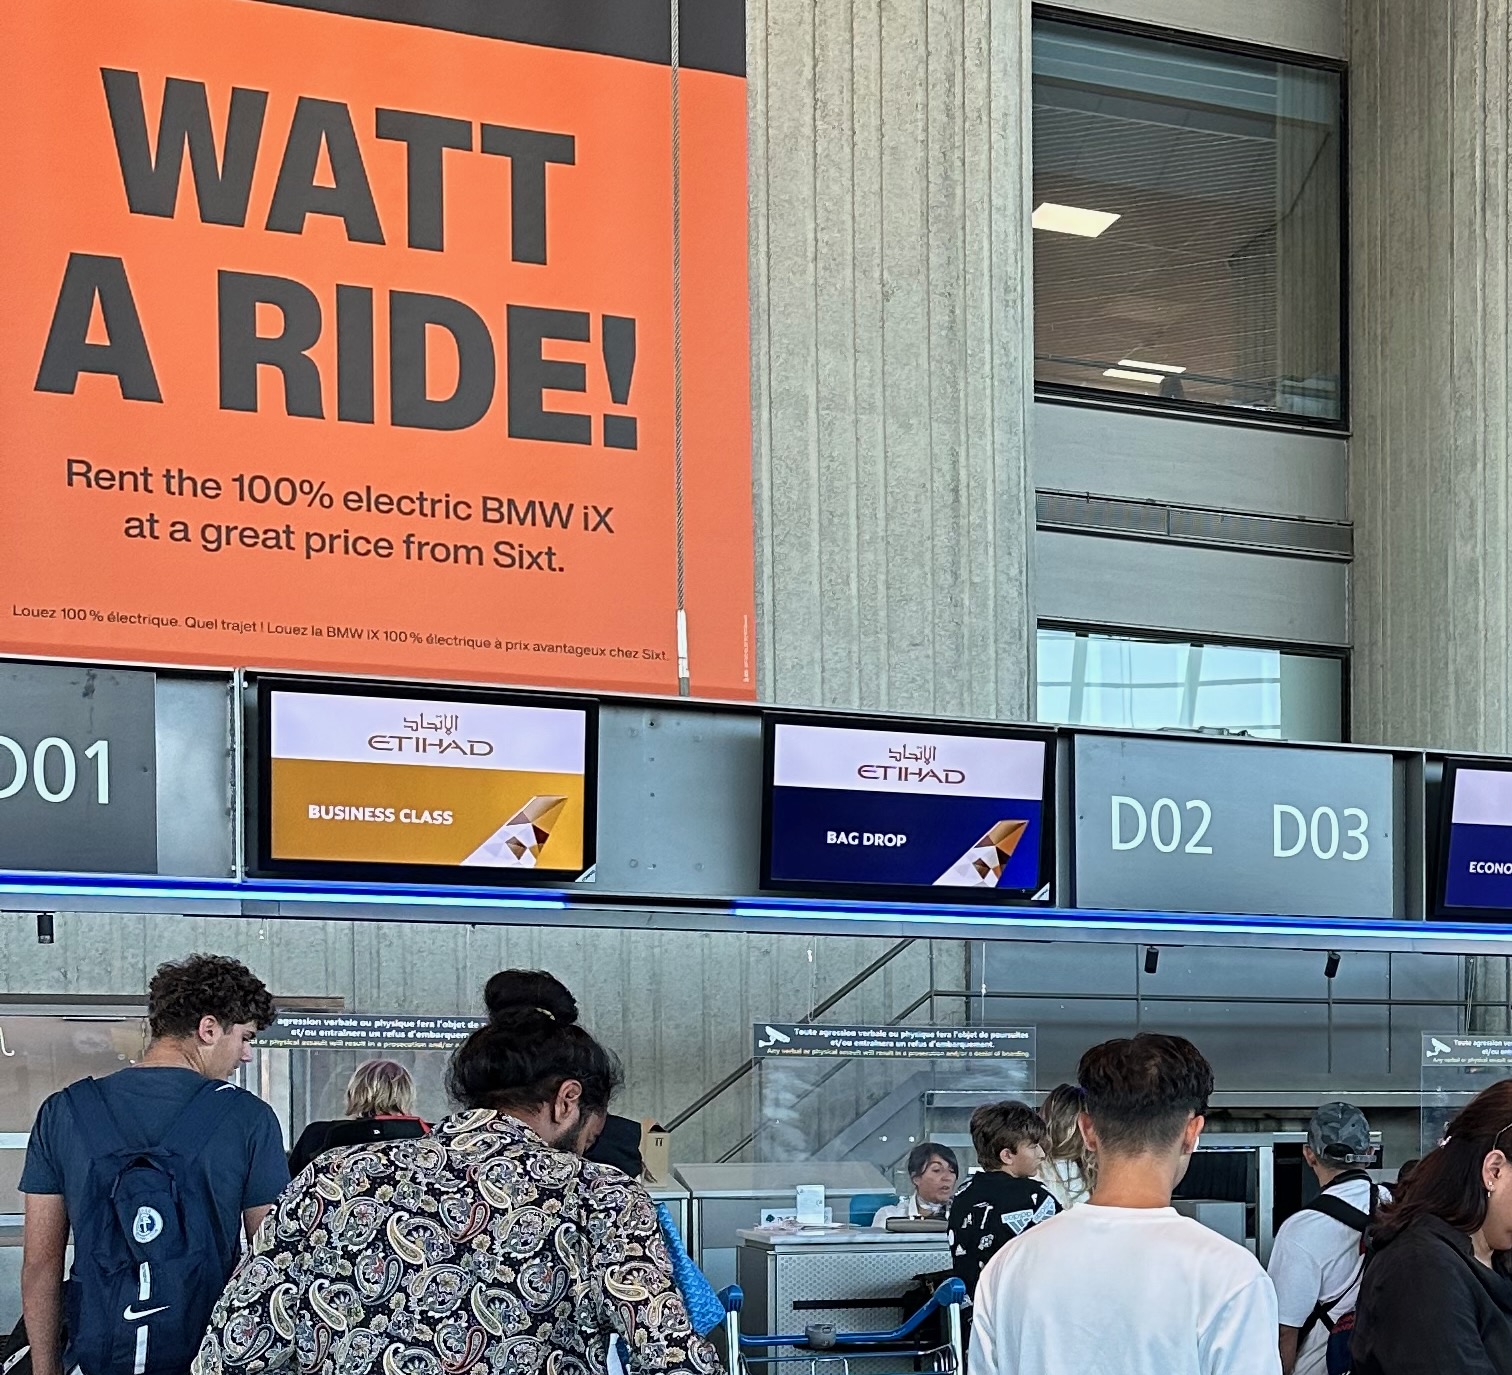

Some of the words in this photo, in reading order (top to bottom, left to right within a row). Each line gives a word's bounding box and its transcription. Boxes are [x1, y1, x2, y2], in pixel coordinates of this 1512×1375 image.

[100, 67, 576, 265] WATT
[34, 252, 163, 403] A
[217, 269, 638, 450] RIDE!
[66, 459, 153, 496] Rent
[163, 468, 222, 499] the
[232, 474, 334, 510] 100%
[343, 485, 472, 522] electric
[482, 497, 574, 529] BMW
[582, 503, 615, 534] iX
[124, 514, 159, 539] at
[169, 521, 190, 542] a
[201, 520, 295, 552] great
[304, 528, 393, 560] price
[403, 534, 484, 565] from
[493, 541, 565, 573] Sixt.
[13, 605, 56, 618] Louez
[185, 617, 218, 630] Quel
[221, 619, 256, 634] trajet
[267, 622, 307, 636] Louez
[311, 624, 322, 637] la
[327, 627, 364, 640] BMW
[426, 632, 491, 649] électrique
[505, 640, 530, 653] prix
[533, 642, 606, 658] avantageux
[609, 646, 638, 658] chez
[367, 735, 494, 757] ETIHAD
[857, 764, 966, 785] ETIHAD
[308, 804, 395, 823] BUSINESS
[400, 808, 454, 826] CLASS
[826, 830, 859, 847] BAG
[862, 831, 907, 848] DROP
[1112, 795, 1213, 855] D02
[1273, 804, 1370, 861] D03
